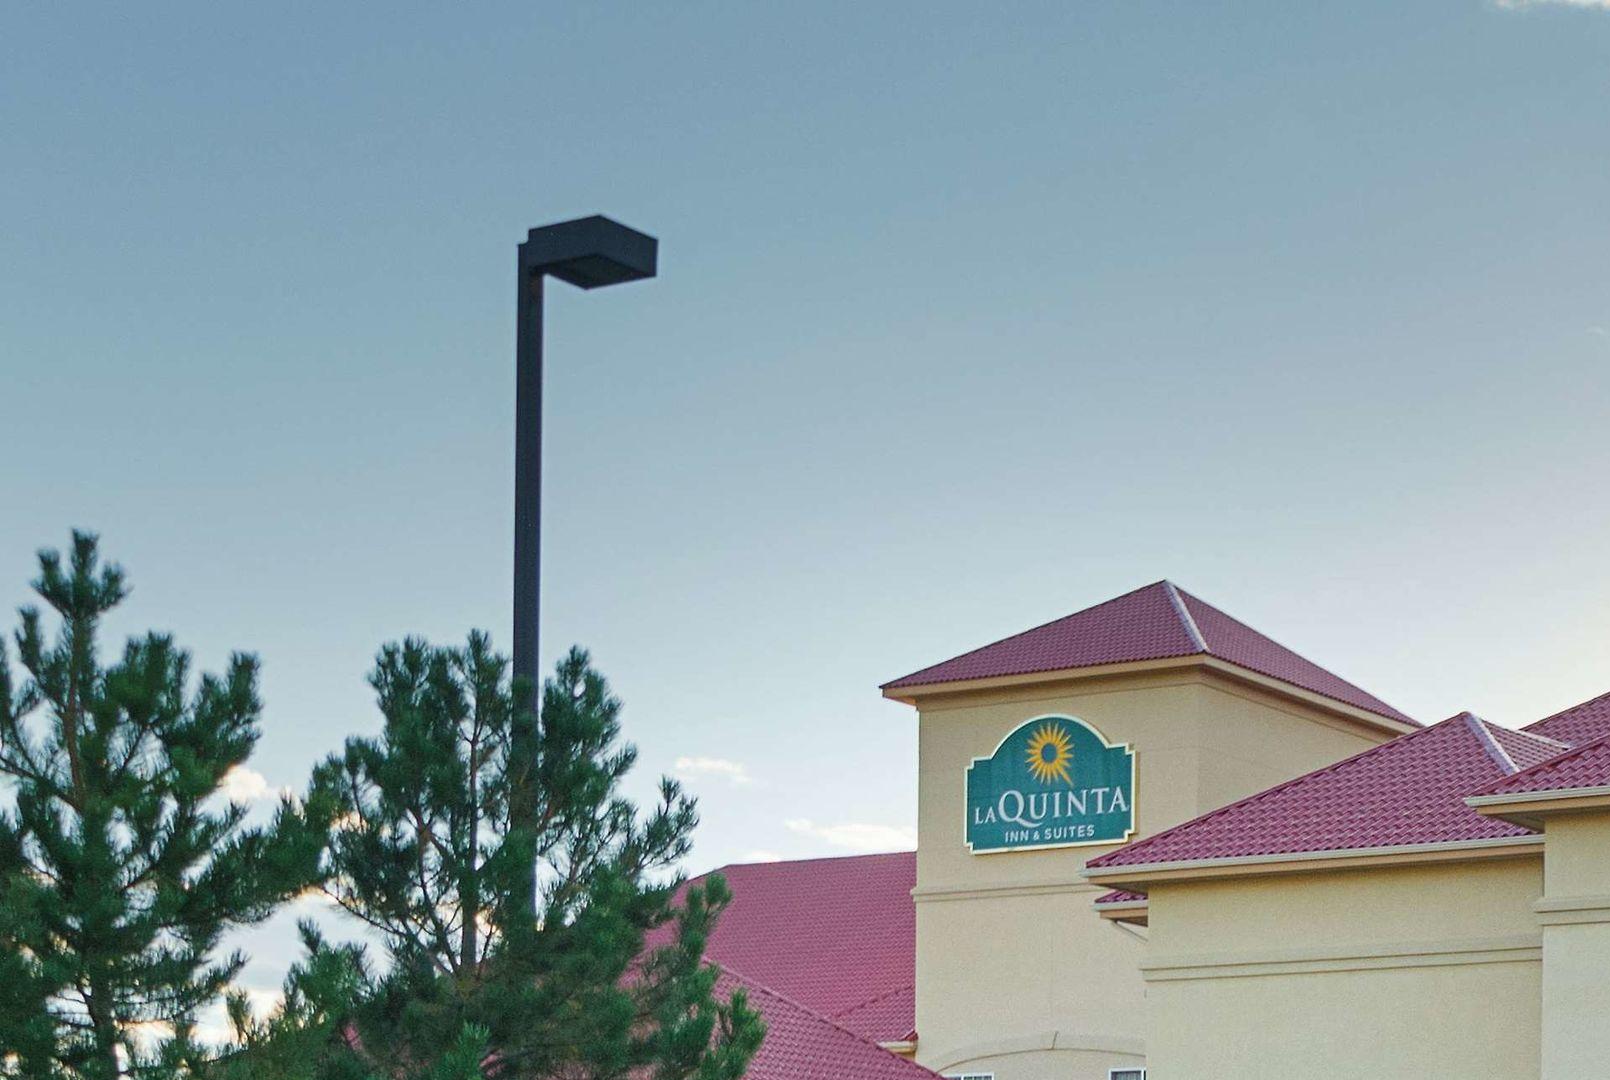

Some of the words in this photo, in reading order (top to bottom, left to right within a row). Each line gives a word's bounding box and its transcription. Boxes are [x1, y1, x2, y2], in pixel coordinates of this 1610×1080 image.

[974, 806, 997, 825] LA
[998, 786, 1130, 828] QUINTA
[1005, 830, 1029, 843] INN
[1032, 831, 1041, 841] &
[1044, 824, 1095, 841] SUITES
